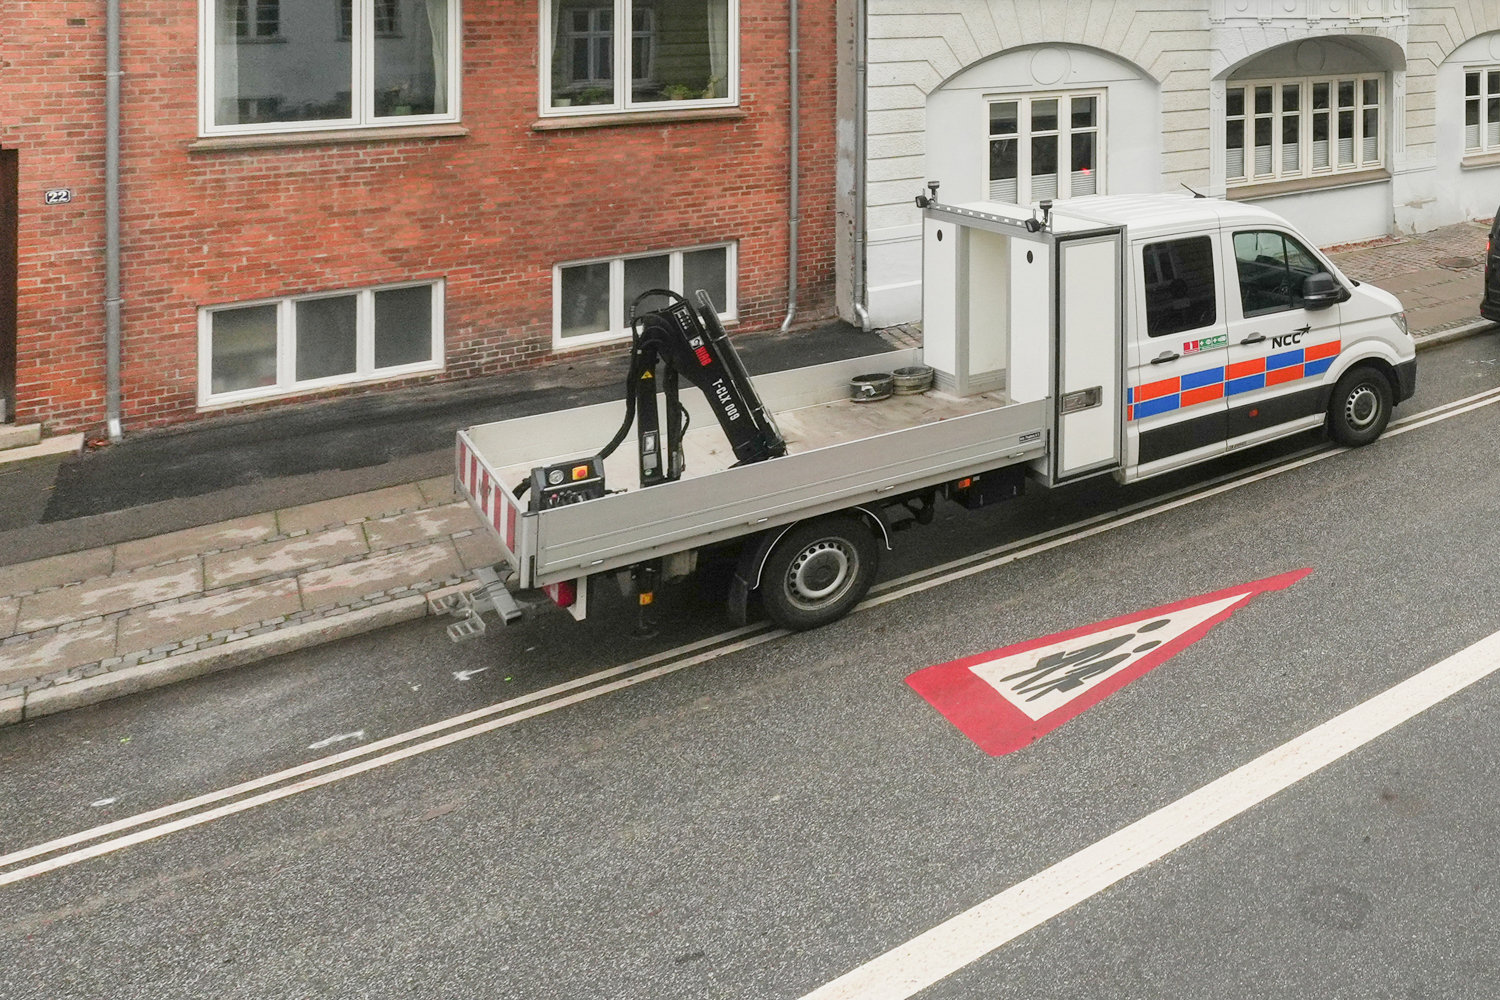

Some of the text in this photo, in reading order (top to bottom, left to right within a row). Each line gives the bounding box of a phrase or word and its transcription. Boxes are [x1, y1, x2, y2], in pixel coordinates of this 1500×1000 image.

[48, 191, 68, 203] 22
[1271, 333, 1301, 349] NCC
[695, 346, 712, 366] HIAB
[725, 403, 741, 421] 009
